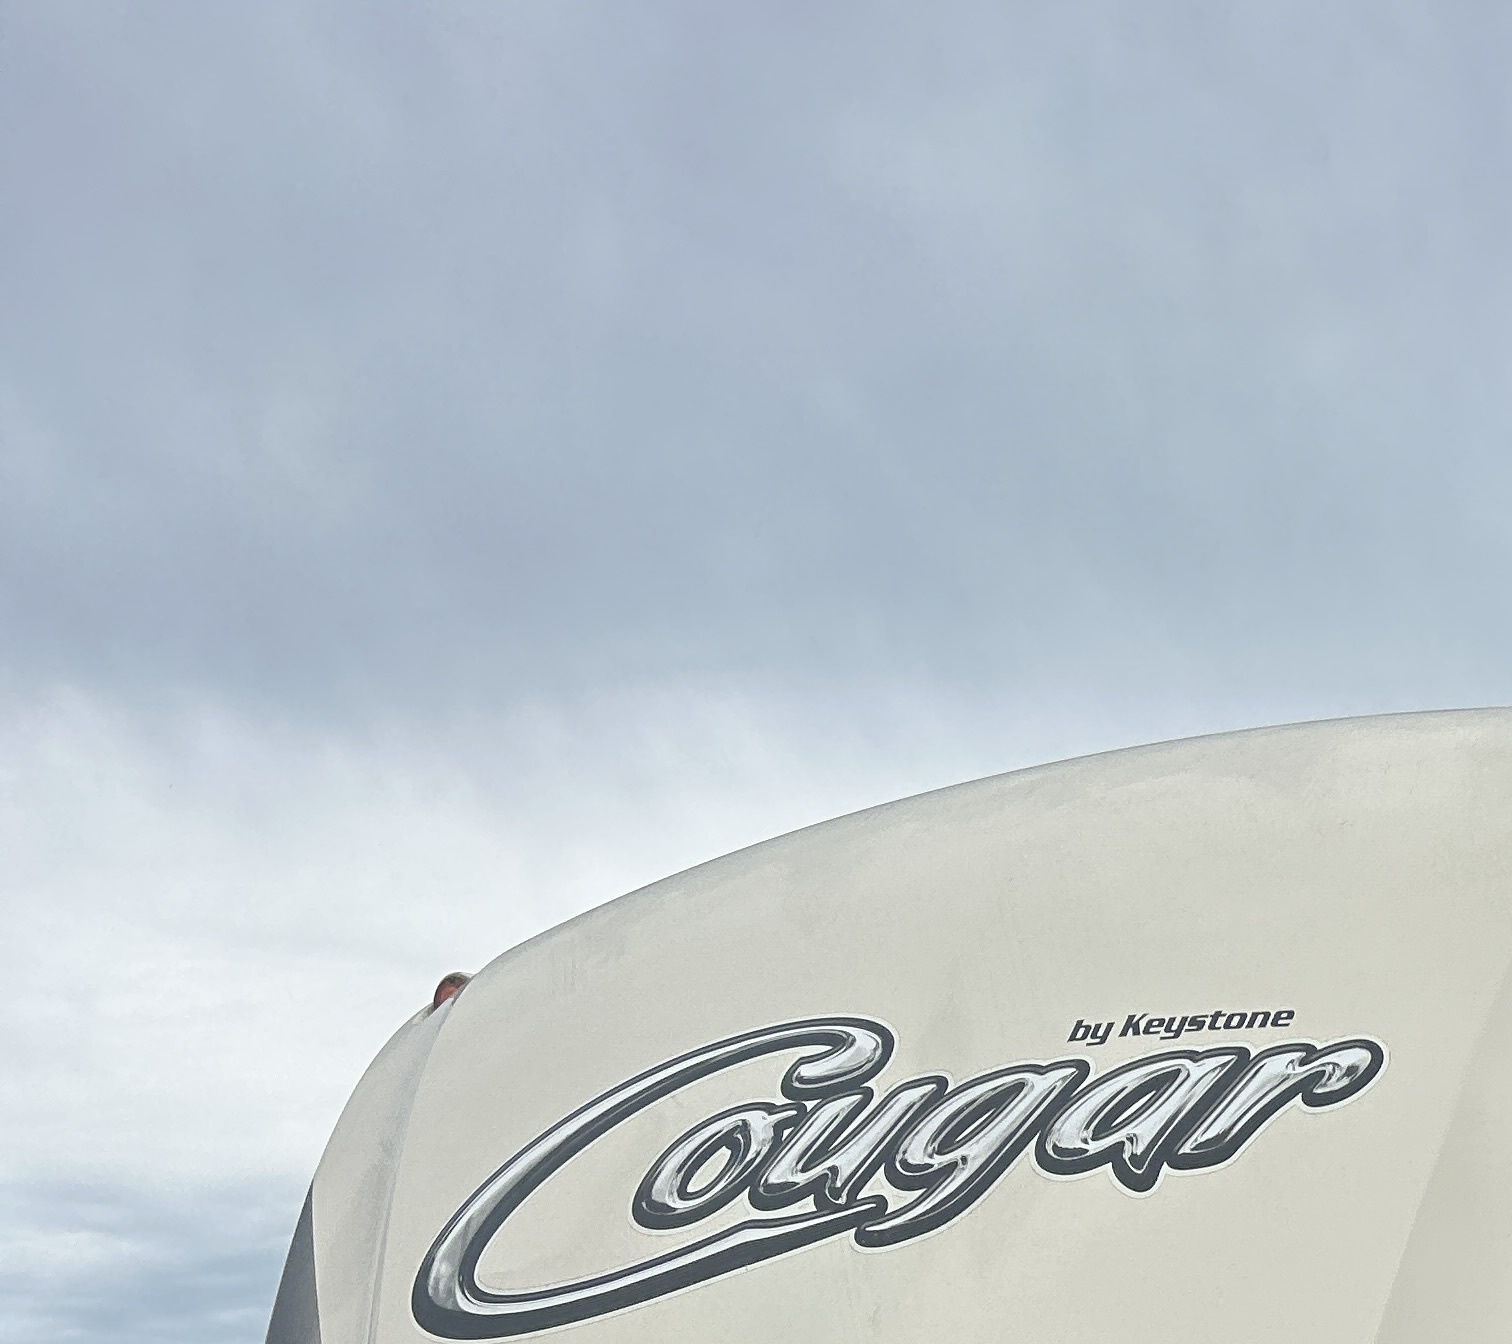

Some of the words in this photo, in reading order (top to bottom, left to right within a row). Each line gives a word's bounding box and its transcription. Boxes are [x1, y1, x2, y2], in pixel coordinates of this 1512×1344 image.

[1066, 1018, 1115, 1047] by
[1118, 1009, 1296, 1041] Keystone
[411, 1016, 1384, 1341] Cougar
